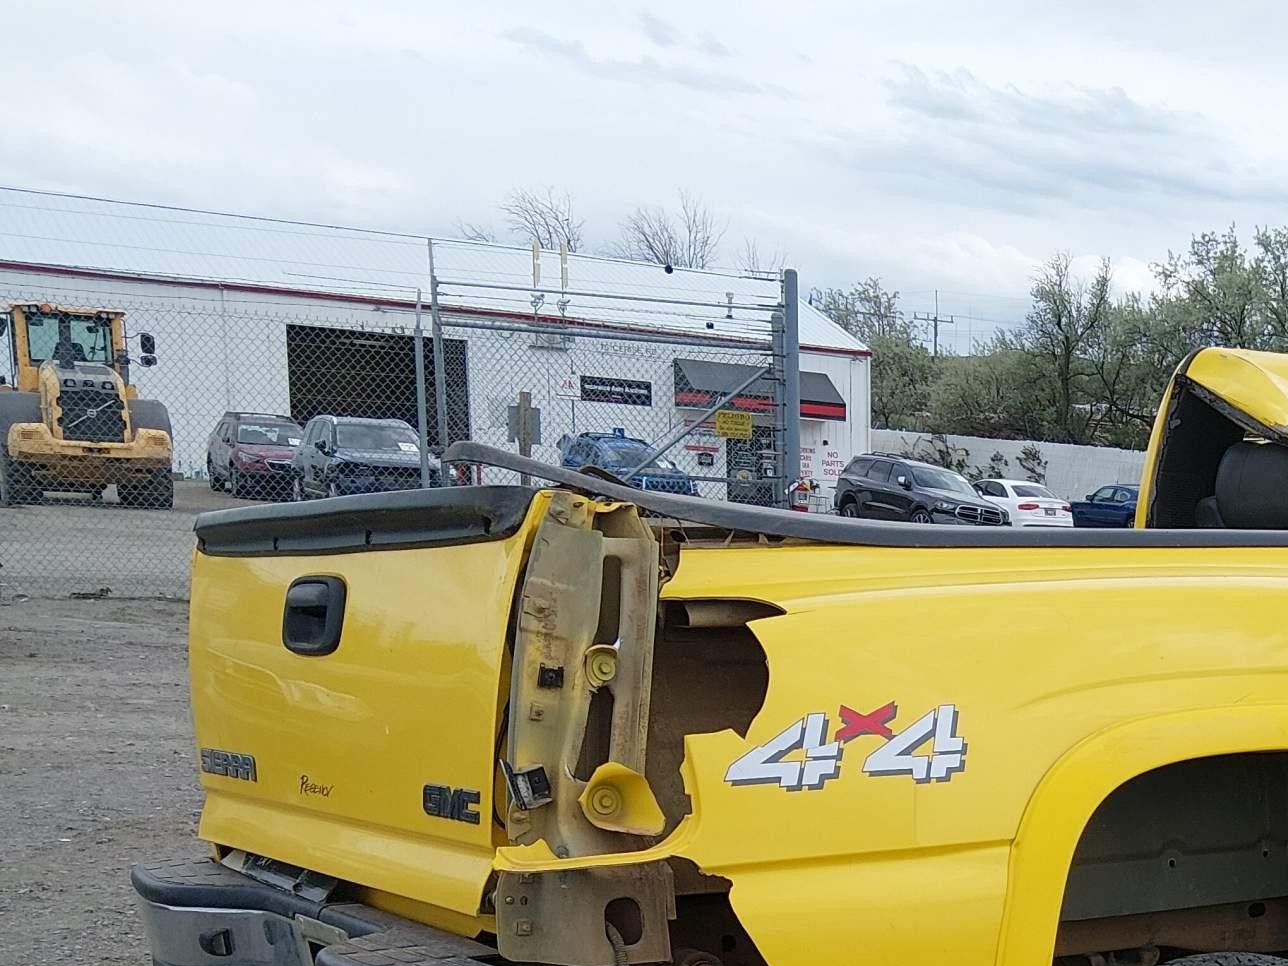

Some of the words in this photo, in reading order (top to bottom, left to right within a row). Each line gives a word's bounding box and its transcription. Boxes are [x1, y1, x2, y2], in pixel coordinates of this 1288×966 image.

[822, 459, 845, 468] PARTS
[827, 451, 839, 459] NO
[200, 747, 257, 782] SIERRA
[423, 783, 480, 824] GMC
